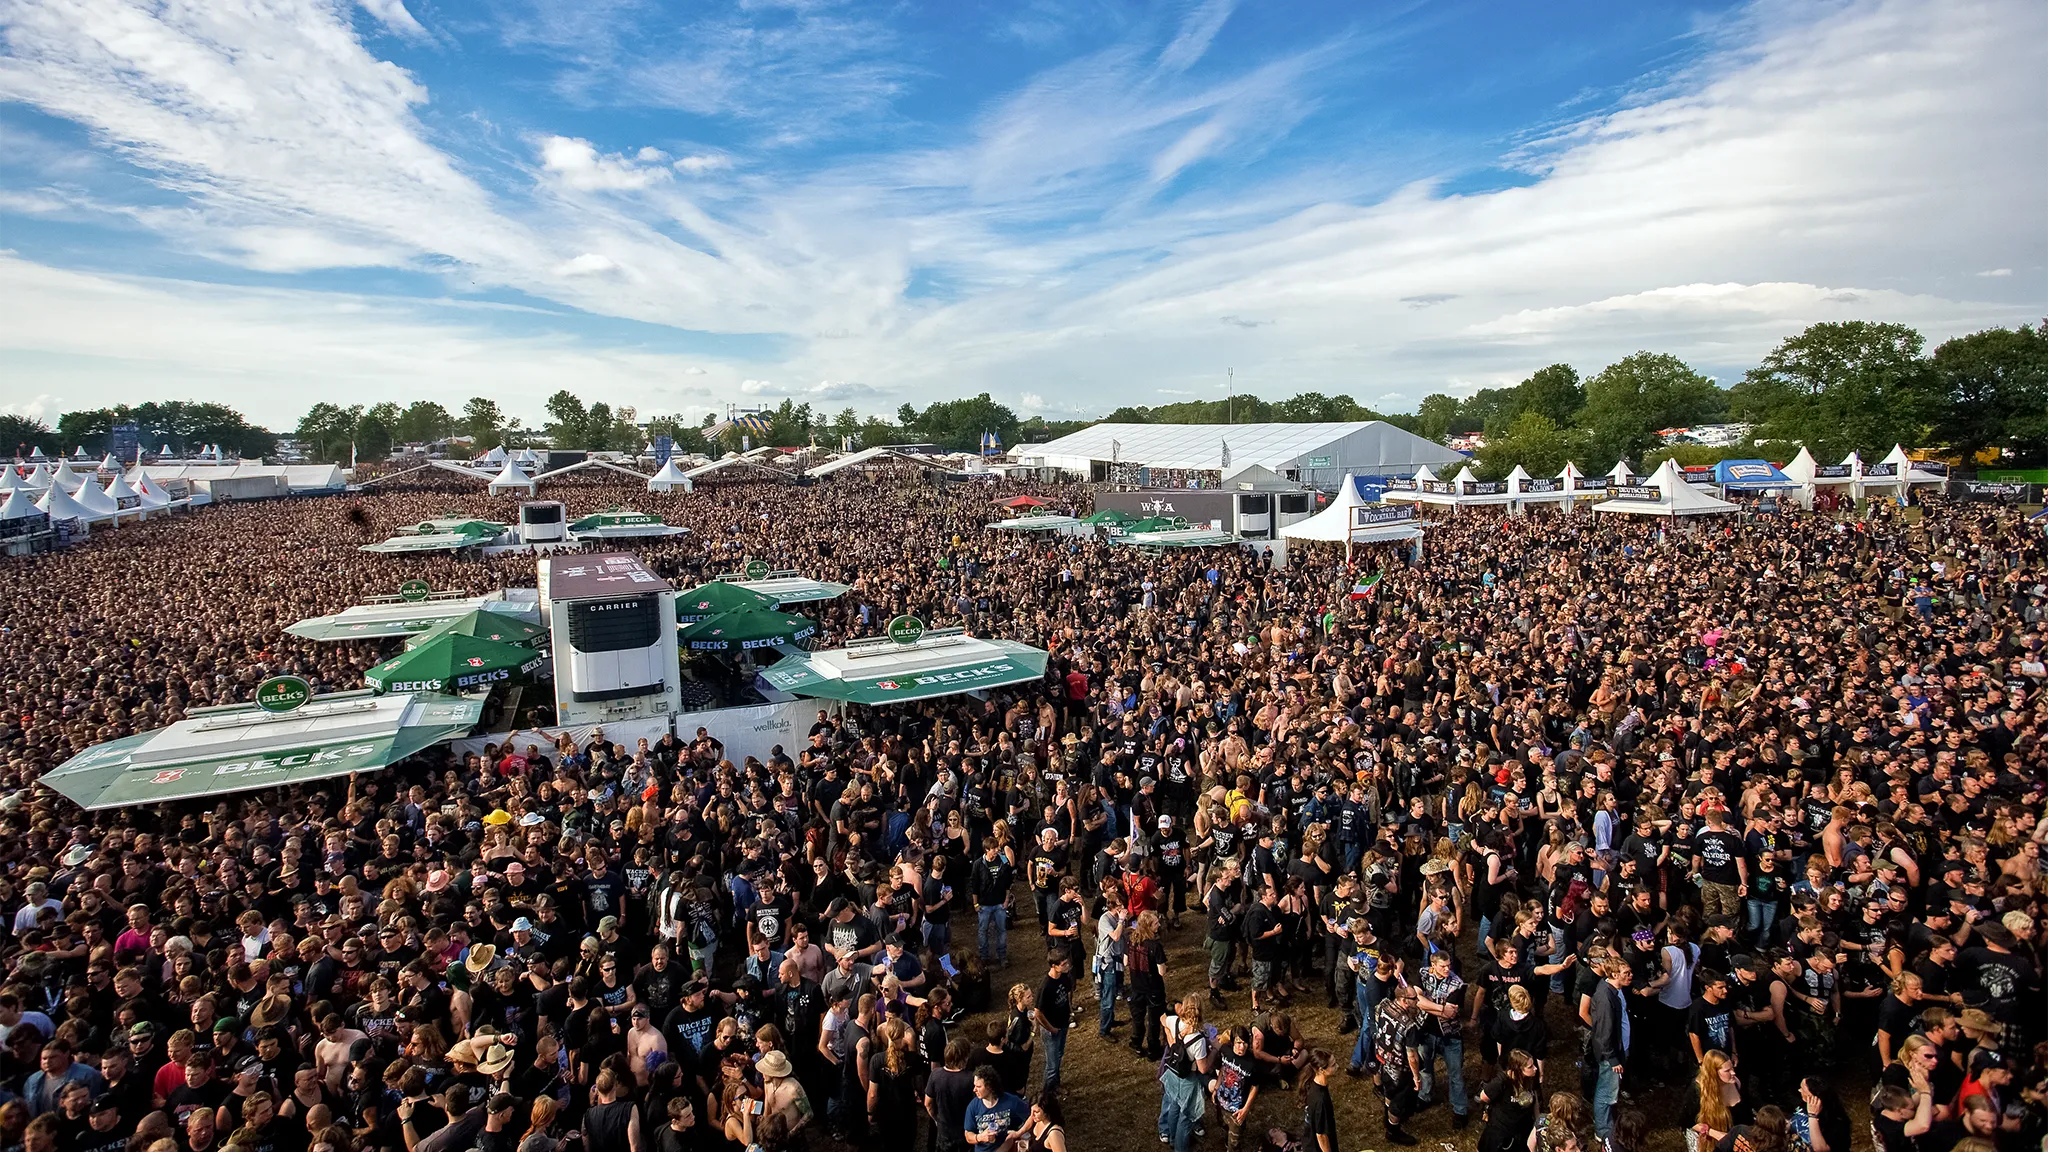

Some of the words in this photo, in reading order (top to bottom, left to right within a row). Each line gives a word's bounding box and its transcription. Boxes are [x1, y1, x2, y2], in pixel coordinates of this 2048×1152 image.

[590, 602, 639, 611] CARRIER
[386, 618, 451, 628] BECK
[794, 625, 815, 641] BECK'S
[895, 627, 921, 635] BECK'S
[691, 639, 729, 650] BECK'S
[742, 636, 785, 650] BECK'S
[521, 657, 544, 674] BECK'S
[458, 669, 510, 687] BECK'S
[913, 663, 1014, 685] BECK'S
[365, 675, 383, 689] BECK'S
[392, 679, 442, 692] BECK'S
[262, 690, 304, 703] BECK'S
[212, 743, 375, 776] BECK'S
[294, 759, 345, 770] GERMANY
[604, 985, 626, 999] WACKEN
[677, 1016, 712, 1033] WACKEN
